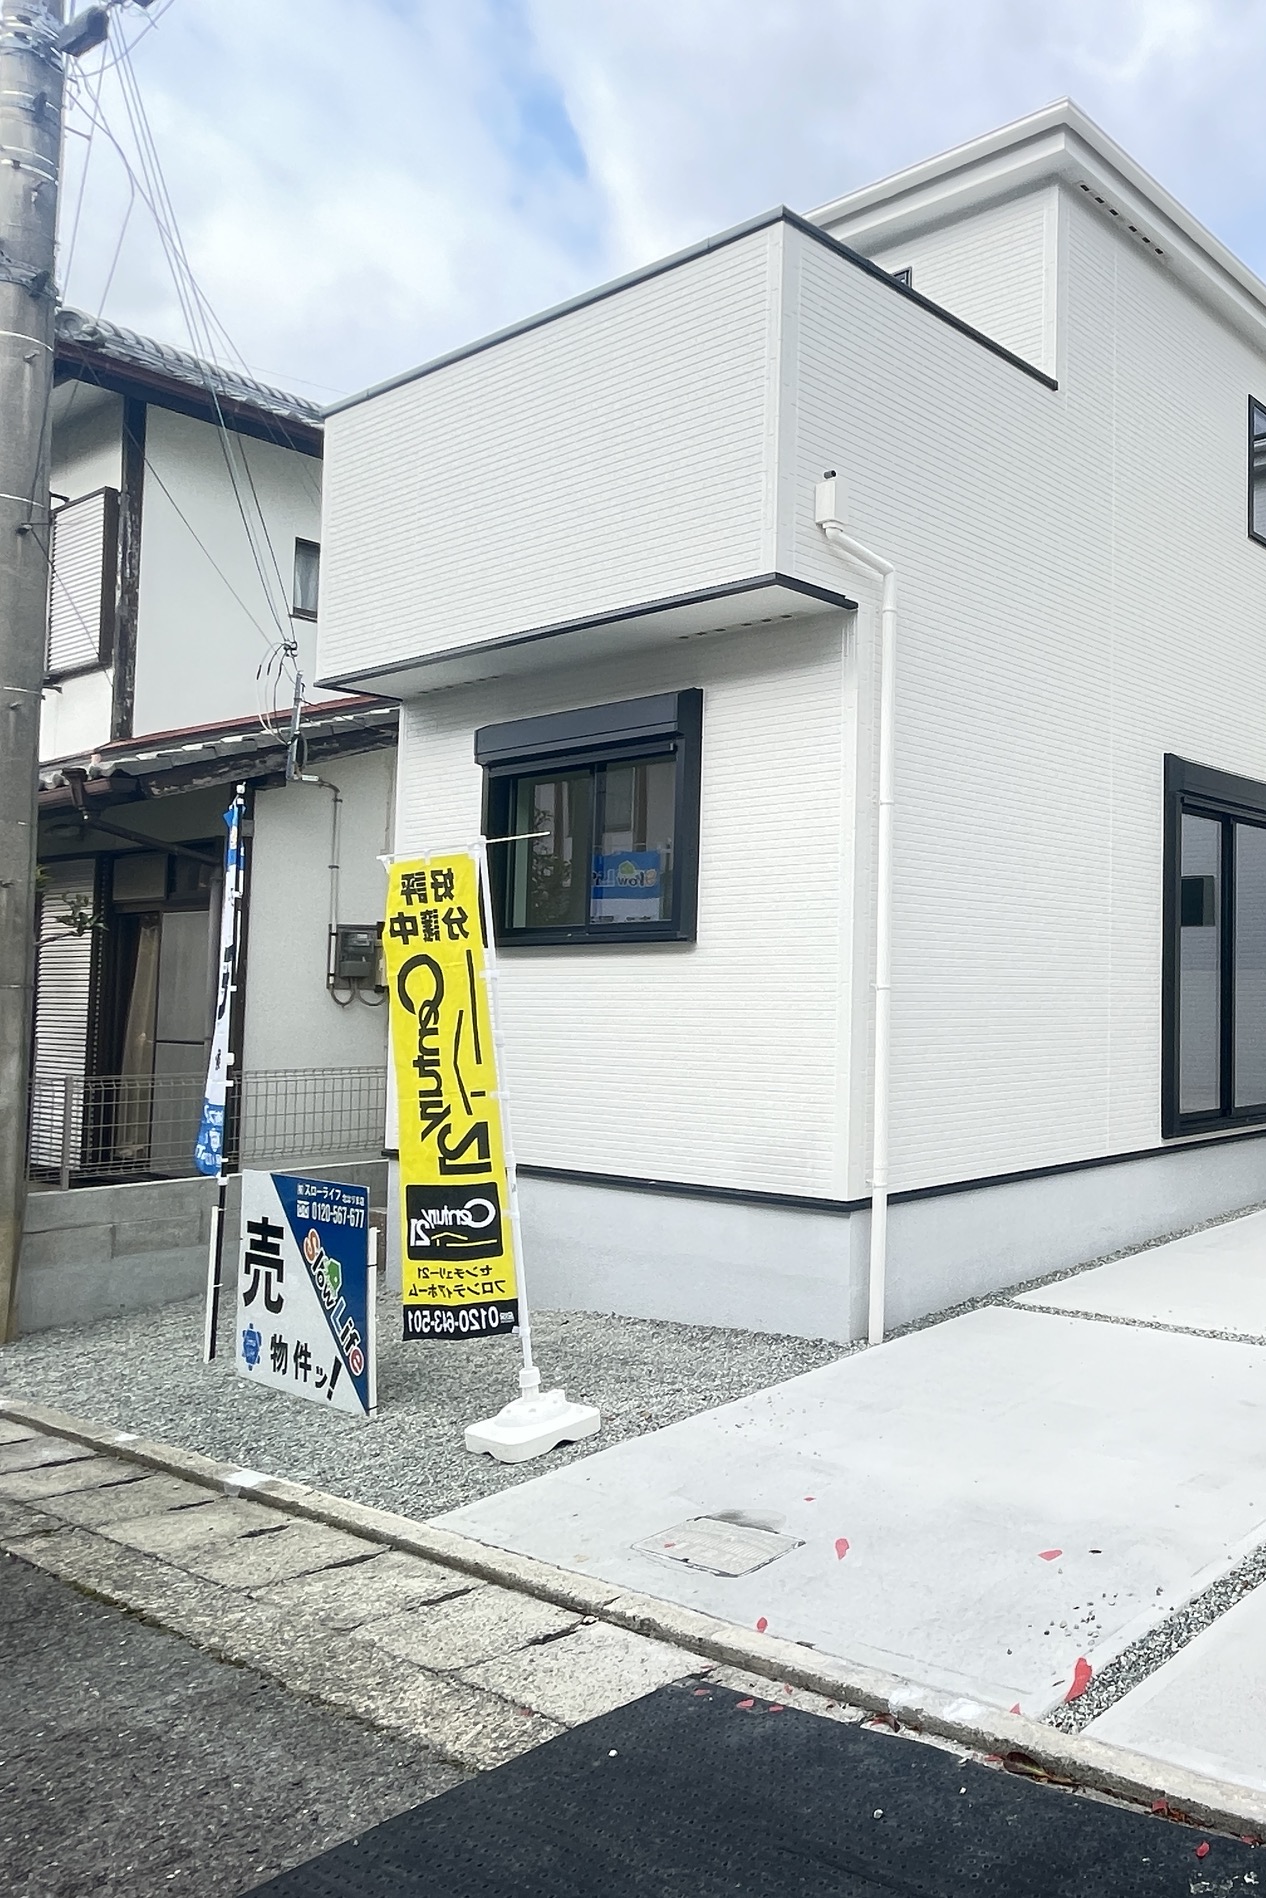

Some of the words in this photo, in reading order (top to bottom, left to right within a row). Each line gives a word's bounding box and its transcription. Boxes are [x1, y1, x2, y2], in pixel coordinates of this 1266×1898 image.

[311, 1201, 365, 1228] 0120-567-677
[243, 1216, 285, 1314] 売
[330, 1297, 364, 1376] Life
